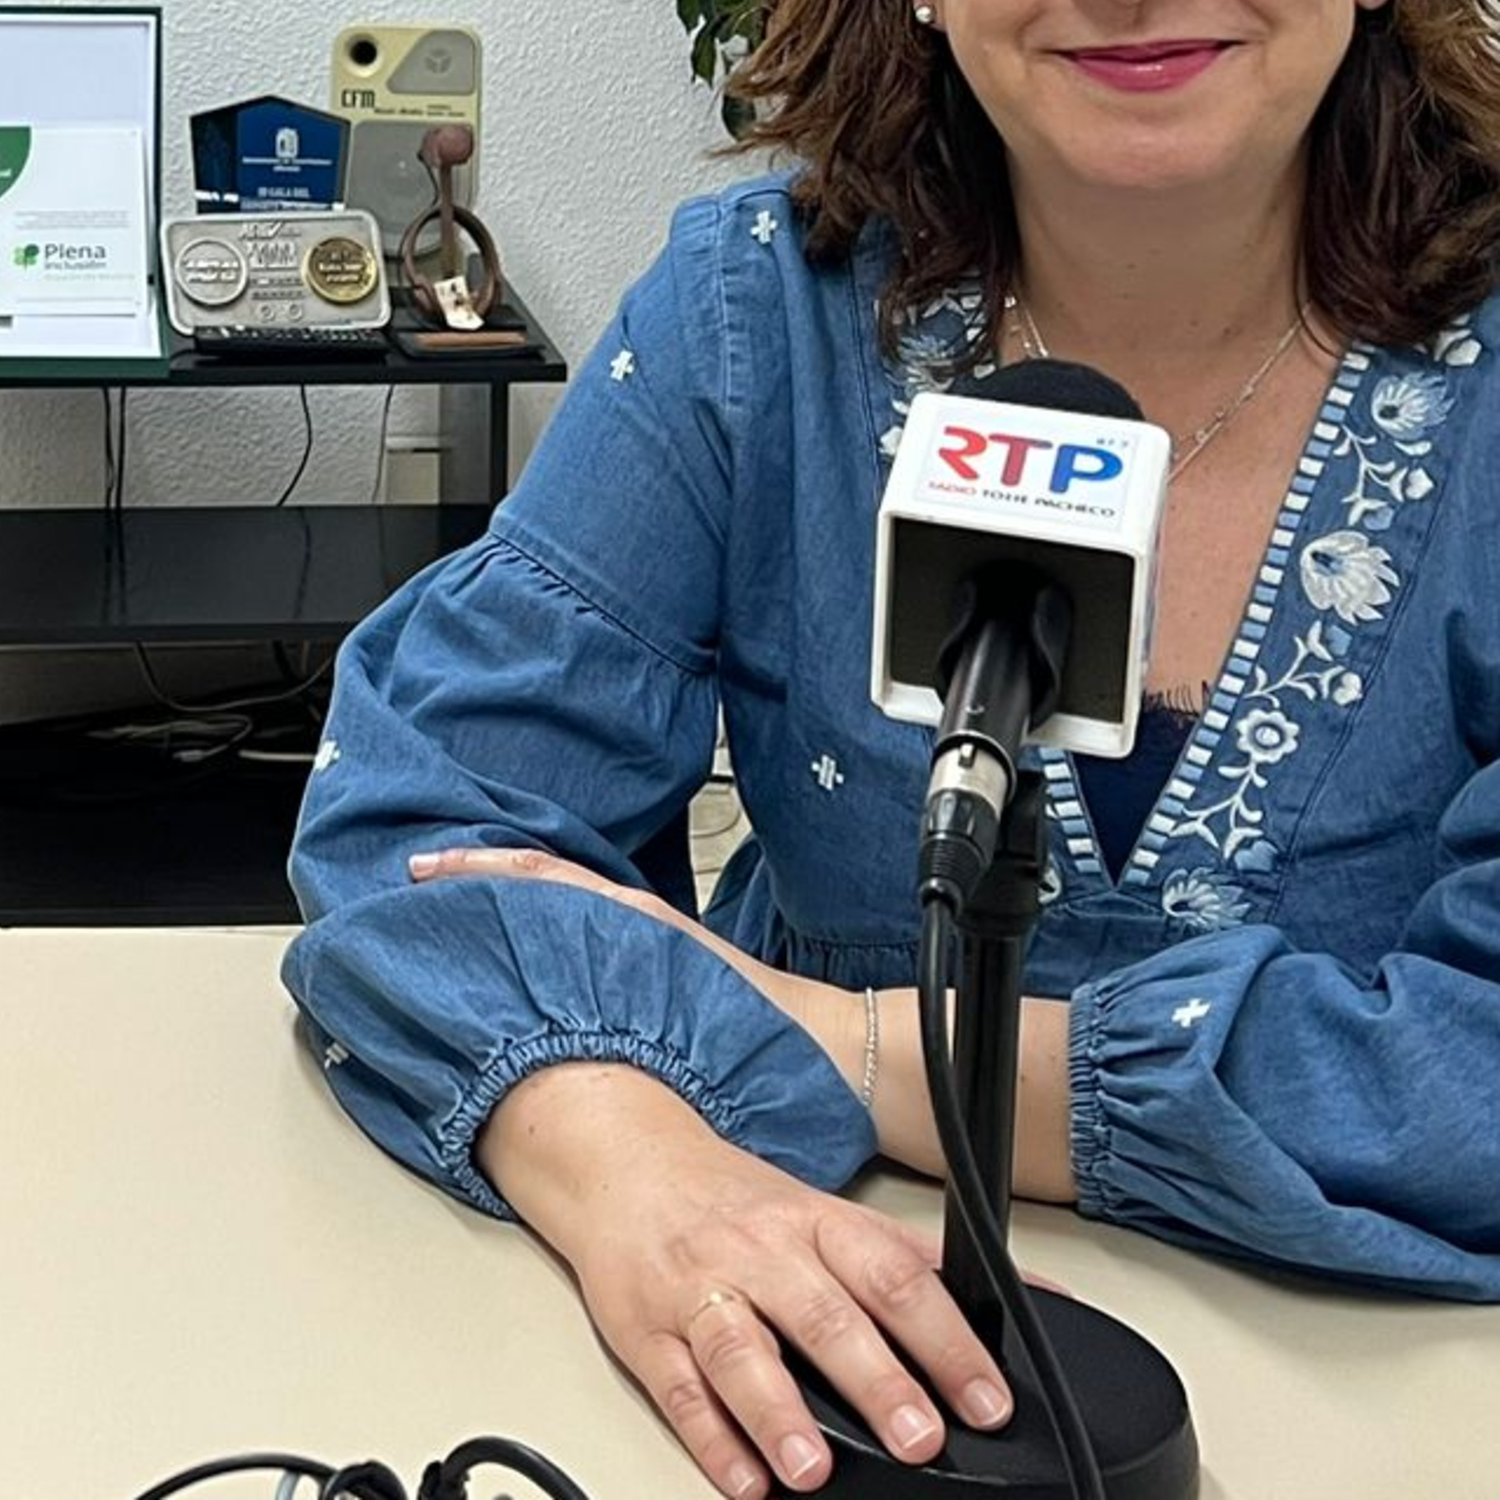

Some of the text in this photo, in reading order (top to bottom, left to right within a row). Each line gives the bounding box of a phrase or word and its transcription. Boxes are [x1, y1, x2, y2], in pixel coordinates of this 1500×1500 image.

[341, 88, 376, 109] CFM
[44, 243, 107, 260] Plena
[938, 426, 1124, 494] RTP
